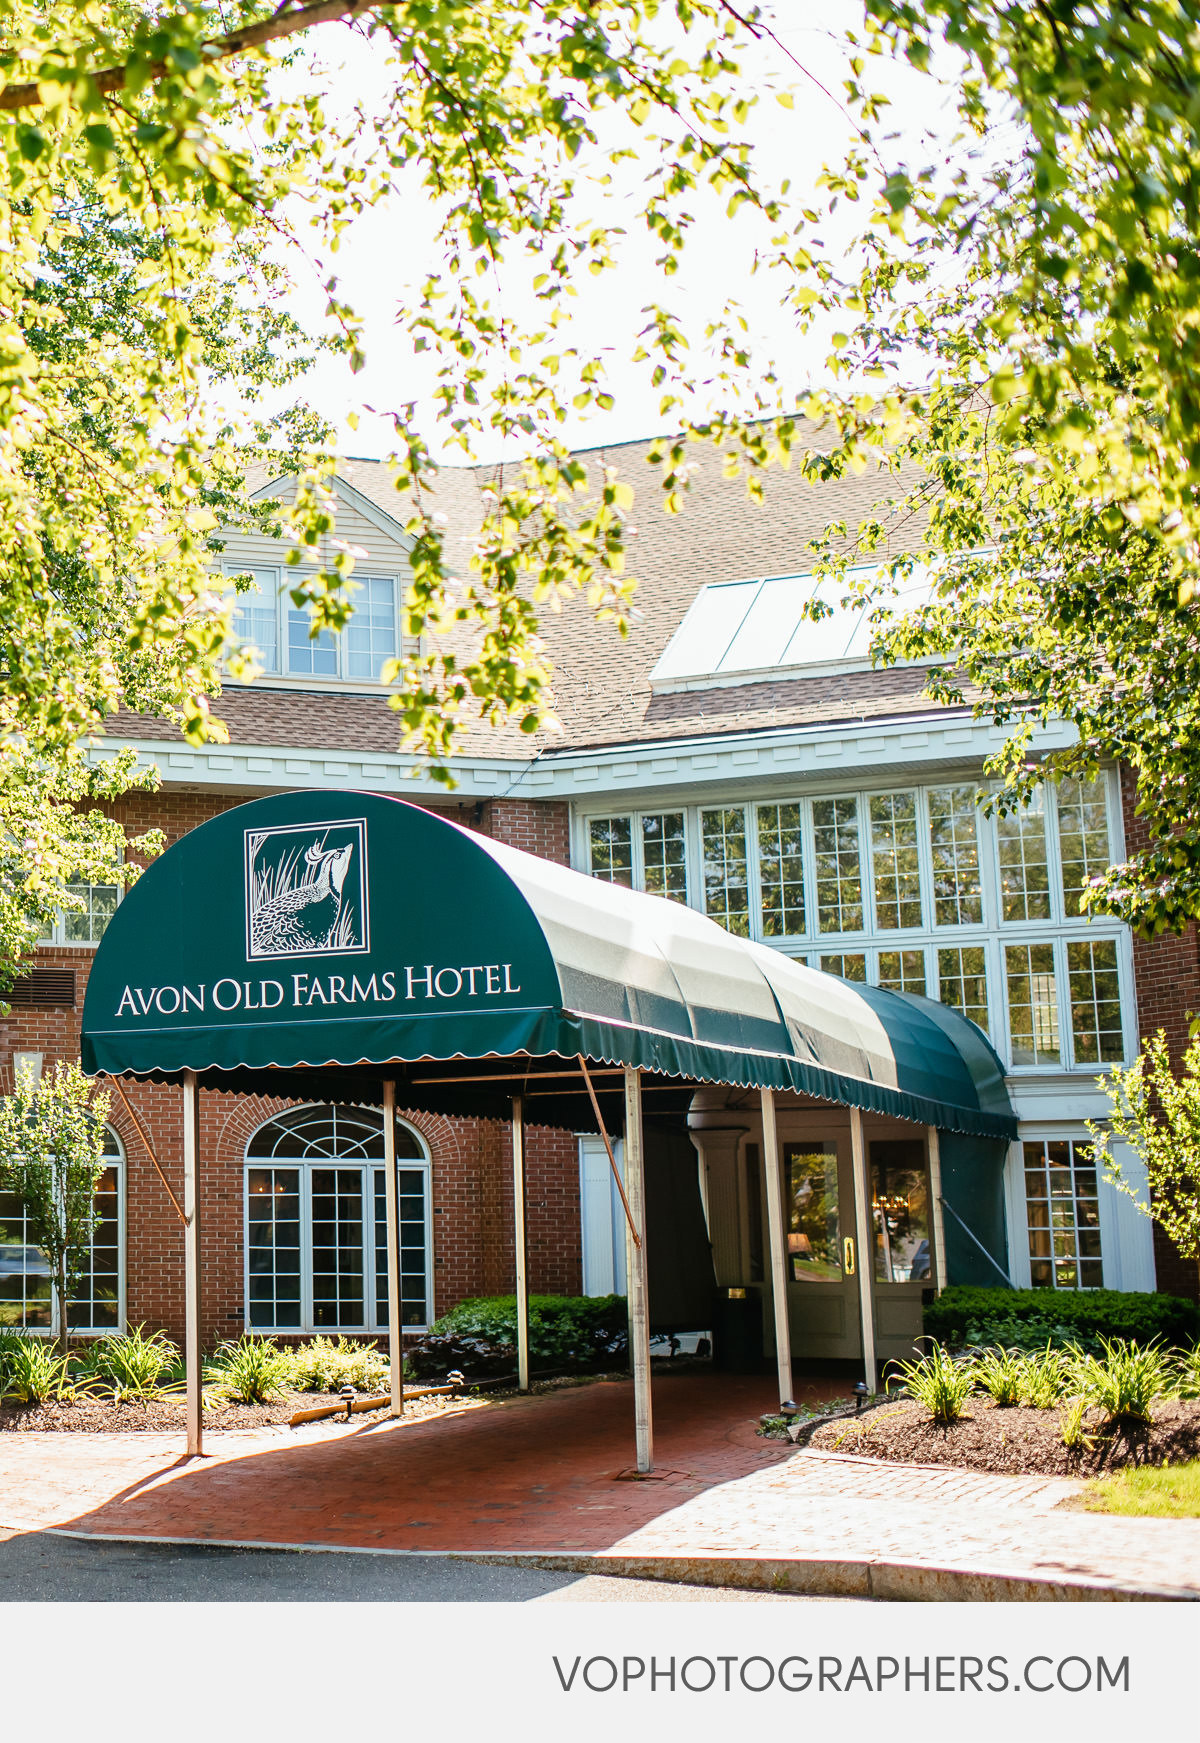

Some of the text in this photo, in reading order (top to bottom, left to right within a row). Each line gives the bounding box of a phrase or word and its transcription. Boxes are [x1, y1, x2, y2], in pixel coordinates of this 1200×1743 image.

[114, 964, 521, 1017] AVON OLD FARMS HOTEL
